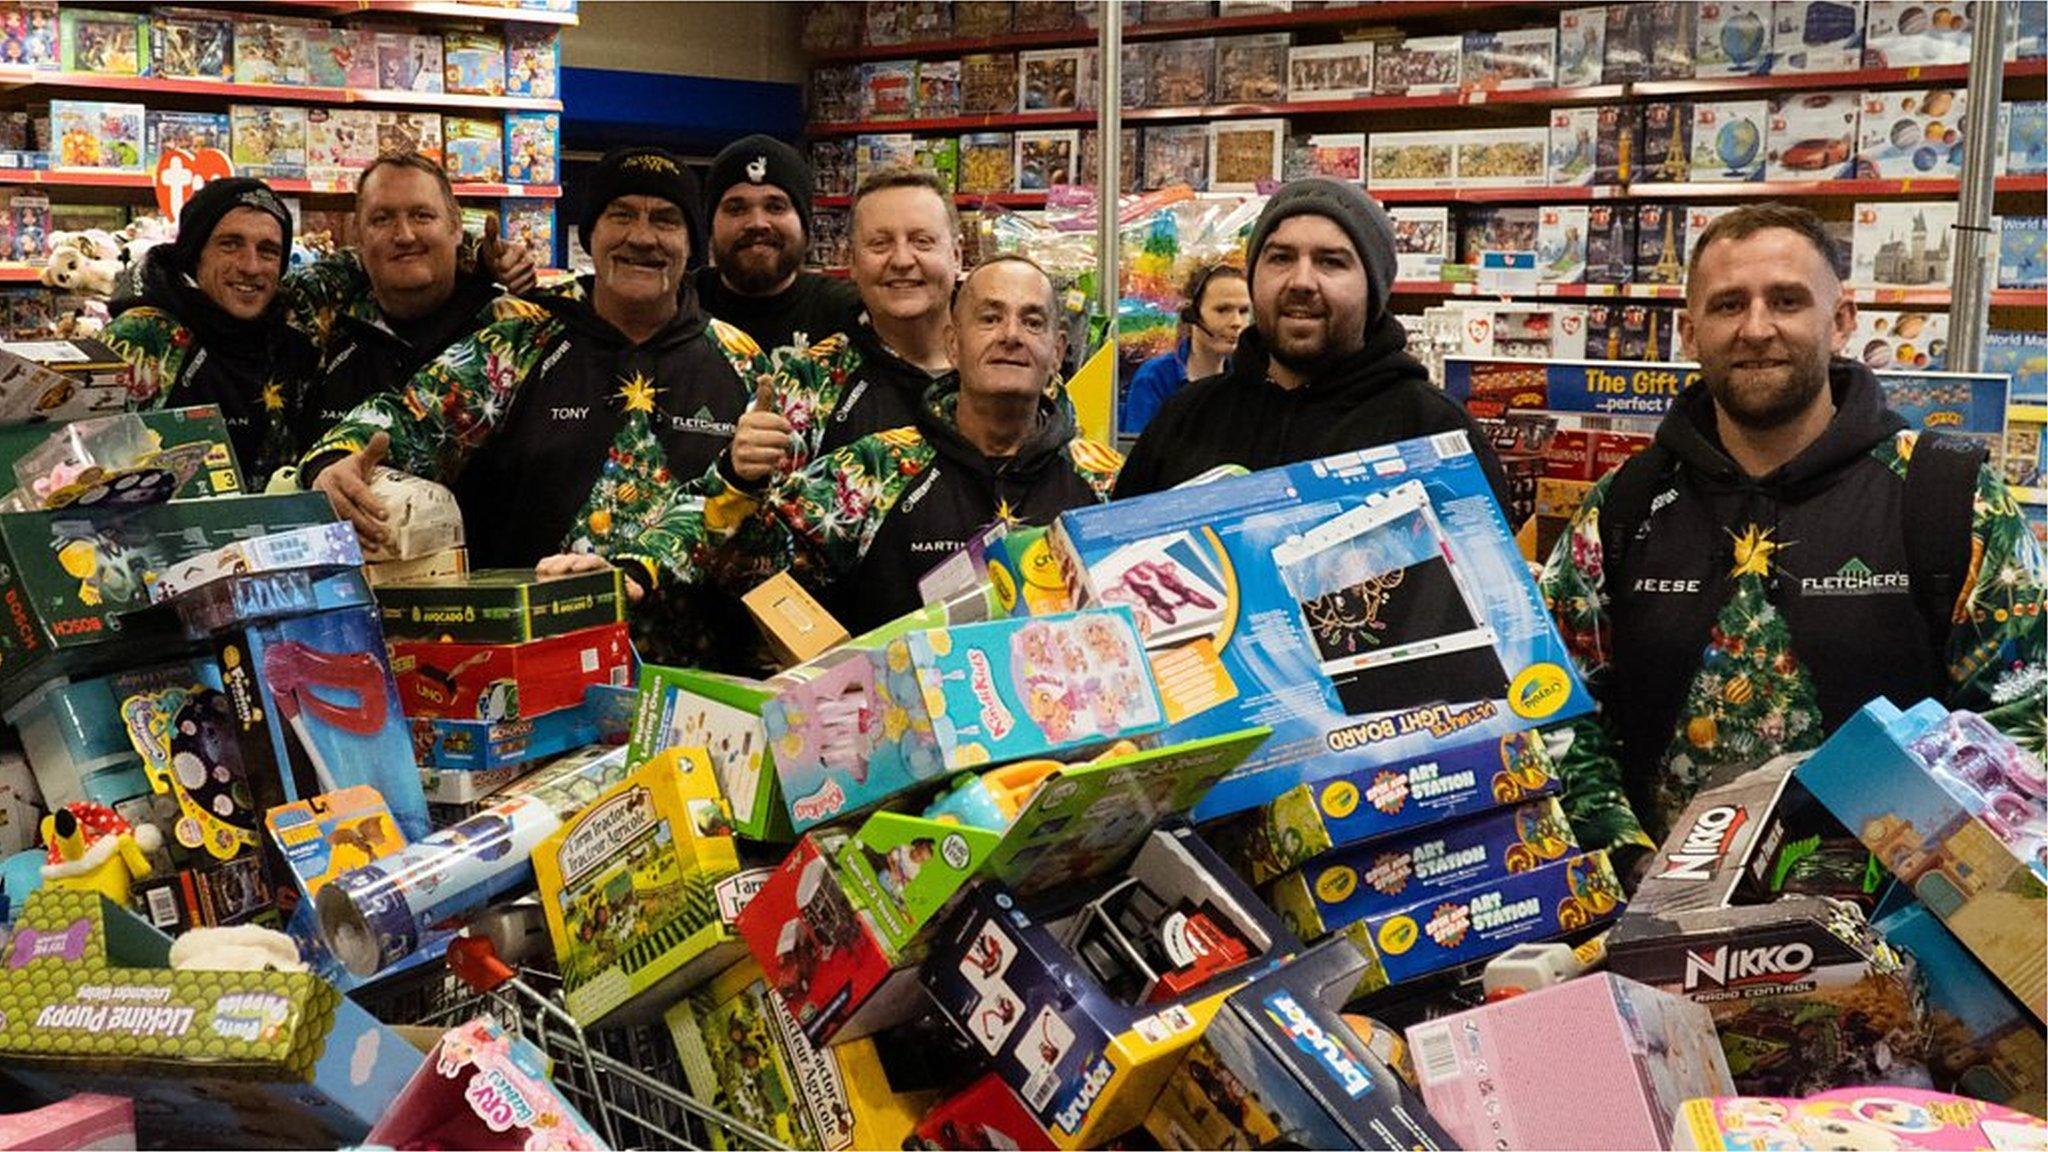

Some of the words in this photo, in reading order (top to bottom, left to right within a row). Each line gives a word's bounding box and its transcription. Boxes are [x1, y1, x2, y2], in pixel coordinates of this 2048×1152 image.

[2004, 218, 2038, 230] World
[1988, 333, 2022, 345] World
[1585, 368, 1627, 394] The
[1633, 370, 1679, 395] Gift
[551, 407, 590, 420] TONY
[224, 472, 236, 487] 3
[1634, 578, 1701, 593] REESE
[1801, 570, 1909, 590] FLETCHER'S
[5, 588, 40, 649] BOSCH
[52, 616, 103, 635] BOSCH
[423, 612, 464, 623] AVOCADO
[415, 684, 444, 704] UNO
[1398, 704, 1452, 735] LIGHT
[1327, 716, 1396, 752] BOARD
[1408, 762, 1439, 783] ART
[1410, 770, 1477, 800] STATION
[567, 839, 607, 873] Tracteur
[607, 810, 646, 843] Agricole
[568, 829, 594, 854] Farm
[591, 805, 626, 836] Tractor
[1659, 805, 1737, 880] NIKKO
[1413, 840, 1446, 862] ART
[1414, 845, 1487, 879] STATION
[1470, 892, 1502, 914] ART
[1472, 898, 1541, 931] STATION
[1684, 942, 1814, 989] NIKKO
[1744, 982, 1812, 998] CONTROL
[37, 1006, 107, 1032] Puppy
[111, 1007, 195, 1035] Licking
[1274, 997, 1371, 1097] bruder
[472, 1086, 513, 1125] CRY
[803, 1066, 836, 1137] Agricole
[1055, 1060, 1112, 1132] bruder
